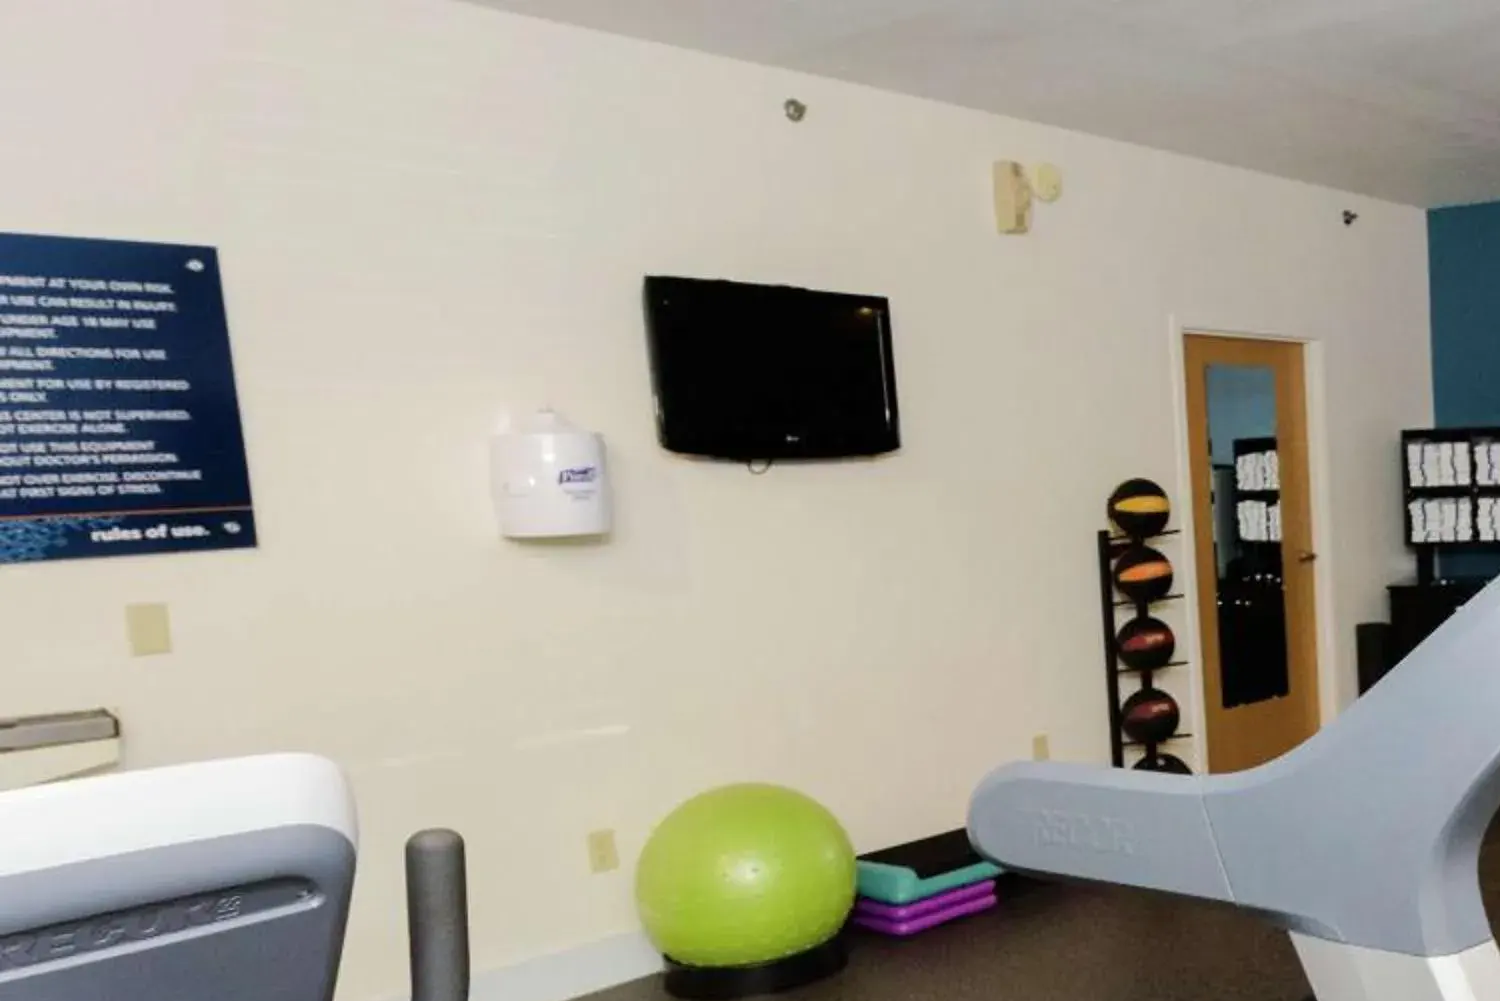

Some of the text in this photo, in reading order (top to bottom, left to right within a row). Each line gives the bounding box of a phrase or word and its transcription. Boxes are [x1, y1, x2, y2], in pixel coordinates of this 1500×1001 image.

[68, 279, 107, 291] YOUR
[90, 523, 212, 543] rules of use.
